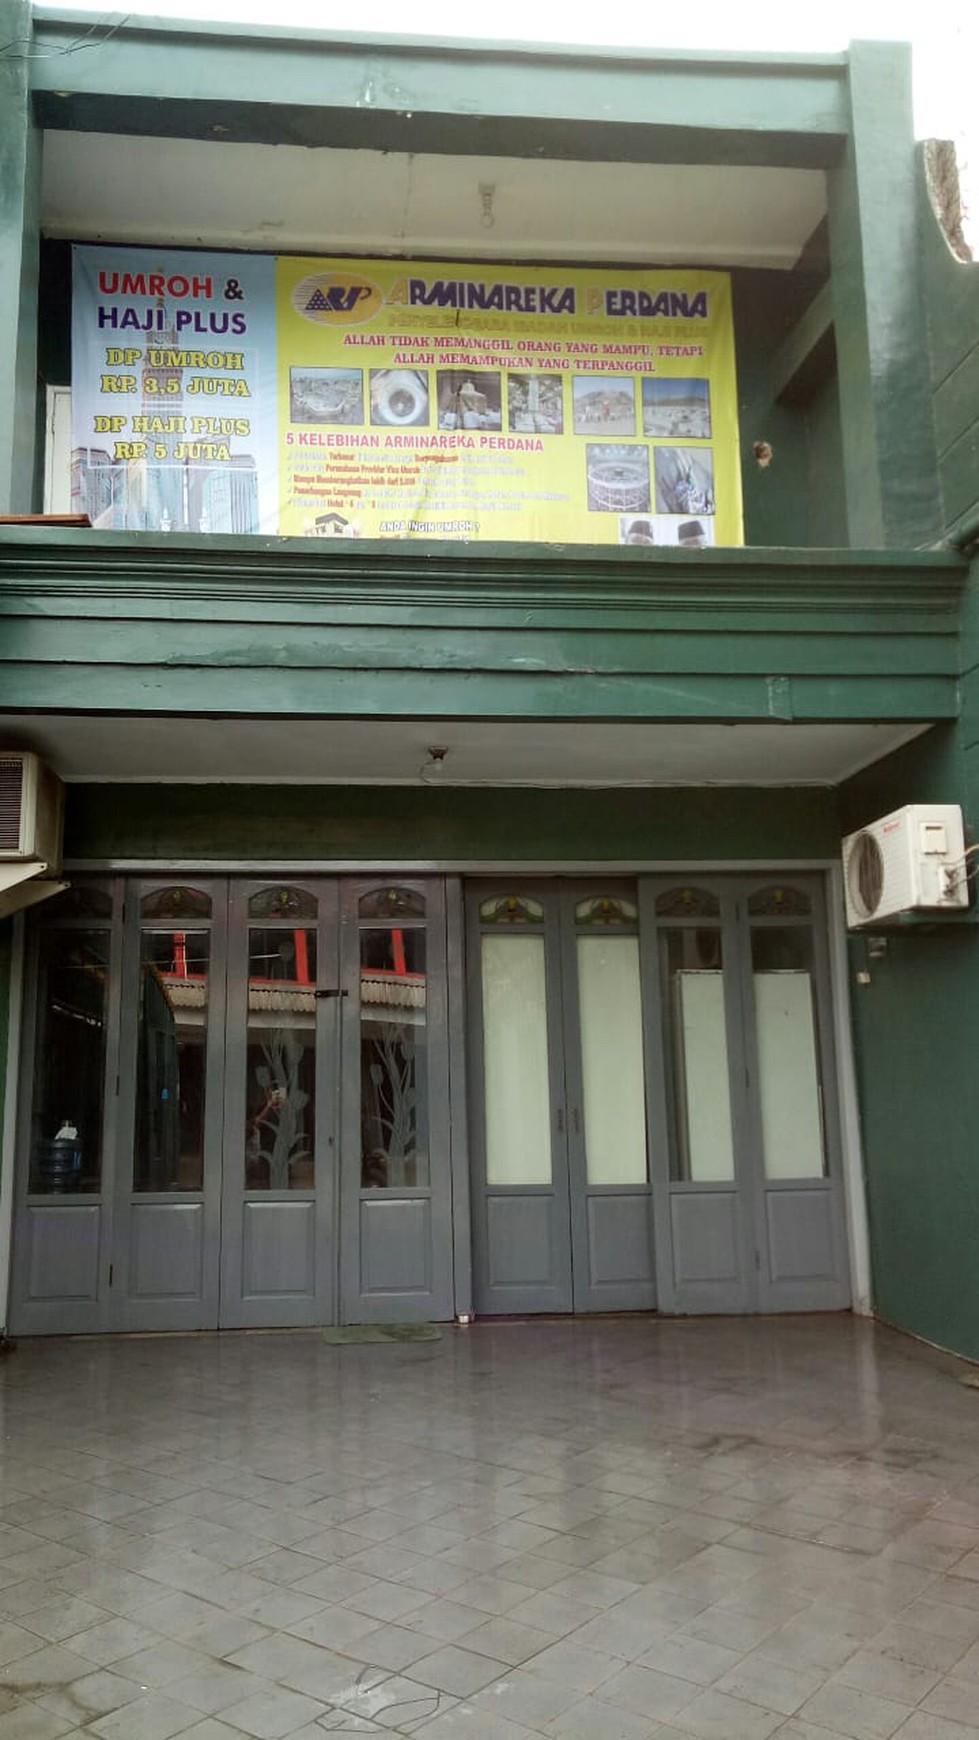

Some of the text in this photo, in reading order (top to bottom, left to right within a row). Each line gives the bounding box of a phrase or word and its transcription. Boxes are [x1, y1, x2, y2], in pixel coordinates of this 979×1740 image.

[99, 271, 244, 300] UMROH &
[386, 276, 708, 318] ARMINAREKA PERDANA
[97, 306, 247, 334] HAJI PLUS
[344, 334, 703, 356] ALLAH TIDAK MEMANGGIL ORANG YANG MAMPU, TETAPI
[106, 348, 244, 370] DP UMROH
[394, 353, 655, 372] ALLAH MEMAMPUKAN YANG TERPANGGIL
[100, 375, 251, 397] RP. 3,5 JUTA
[94, 416, 250, 437] DP HAJI PLUS
[114, 442, 231, 461] RP. 5 JUTA
[287, 433, 544, 451] 5 KELEBIHAN ARMINAREKA PERDANA
[380, 521, 406, 532] ANDA
[408, 521, 435, 533] INGIN
[437, 521, 473, 533] UMROH
